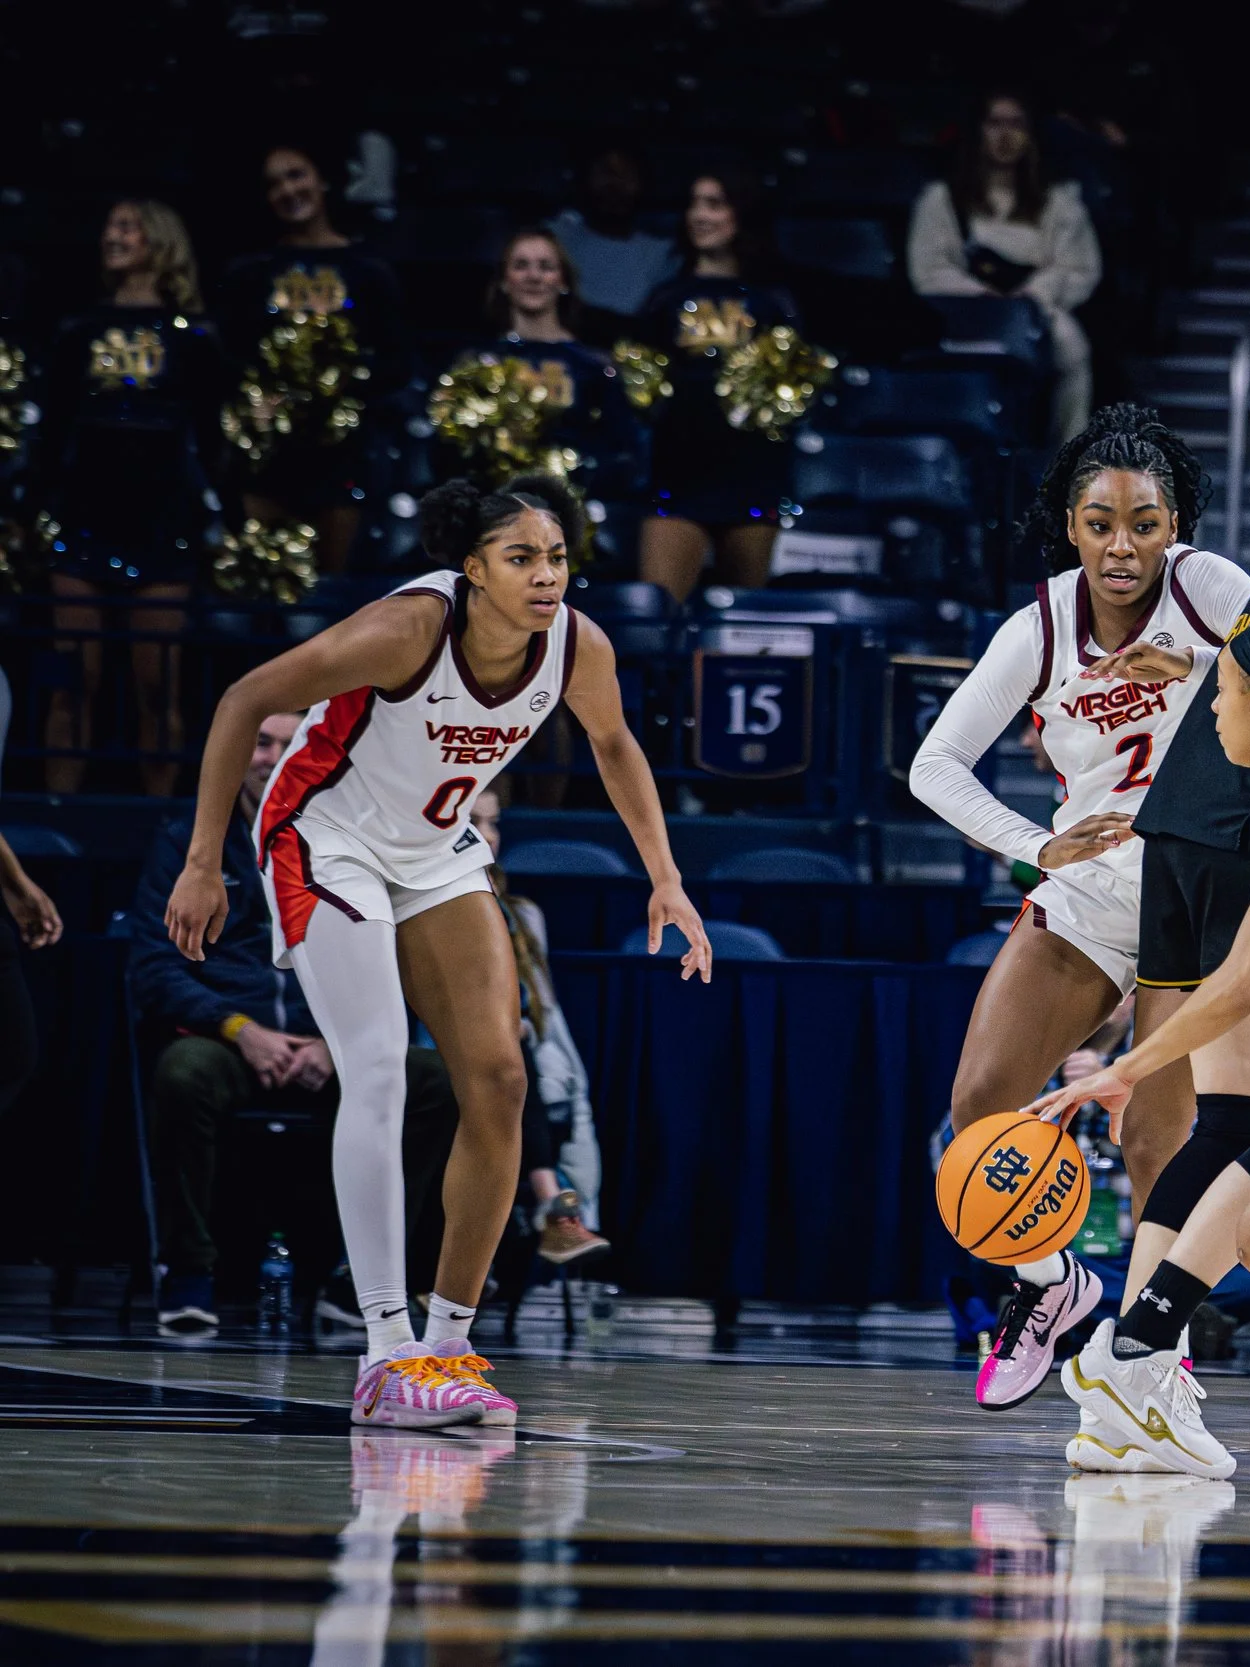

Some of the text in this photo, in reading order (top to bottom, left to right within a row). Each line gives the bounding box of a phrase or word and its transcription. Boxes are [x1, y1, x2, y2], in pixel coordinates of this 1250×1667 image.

[425, 720, 531, 745] VIRGINIA
[724, 684, 783, 736] 15
[1087, 692, 1168, 735] TECH
[440, 746, 509, 764] TECH
[1111, 732, 1153, 793] 2
[421, 776, 478, 829] 0
[1003, 1158, 1079, 1241] Wilson
